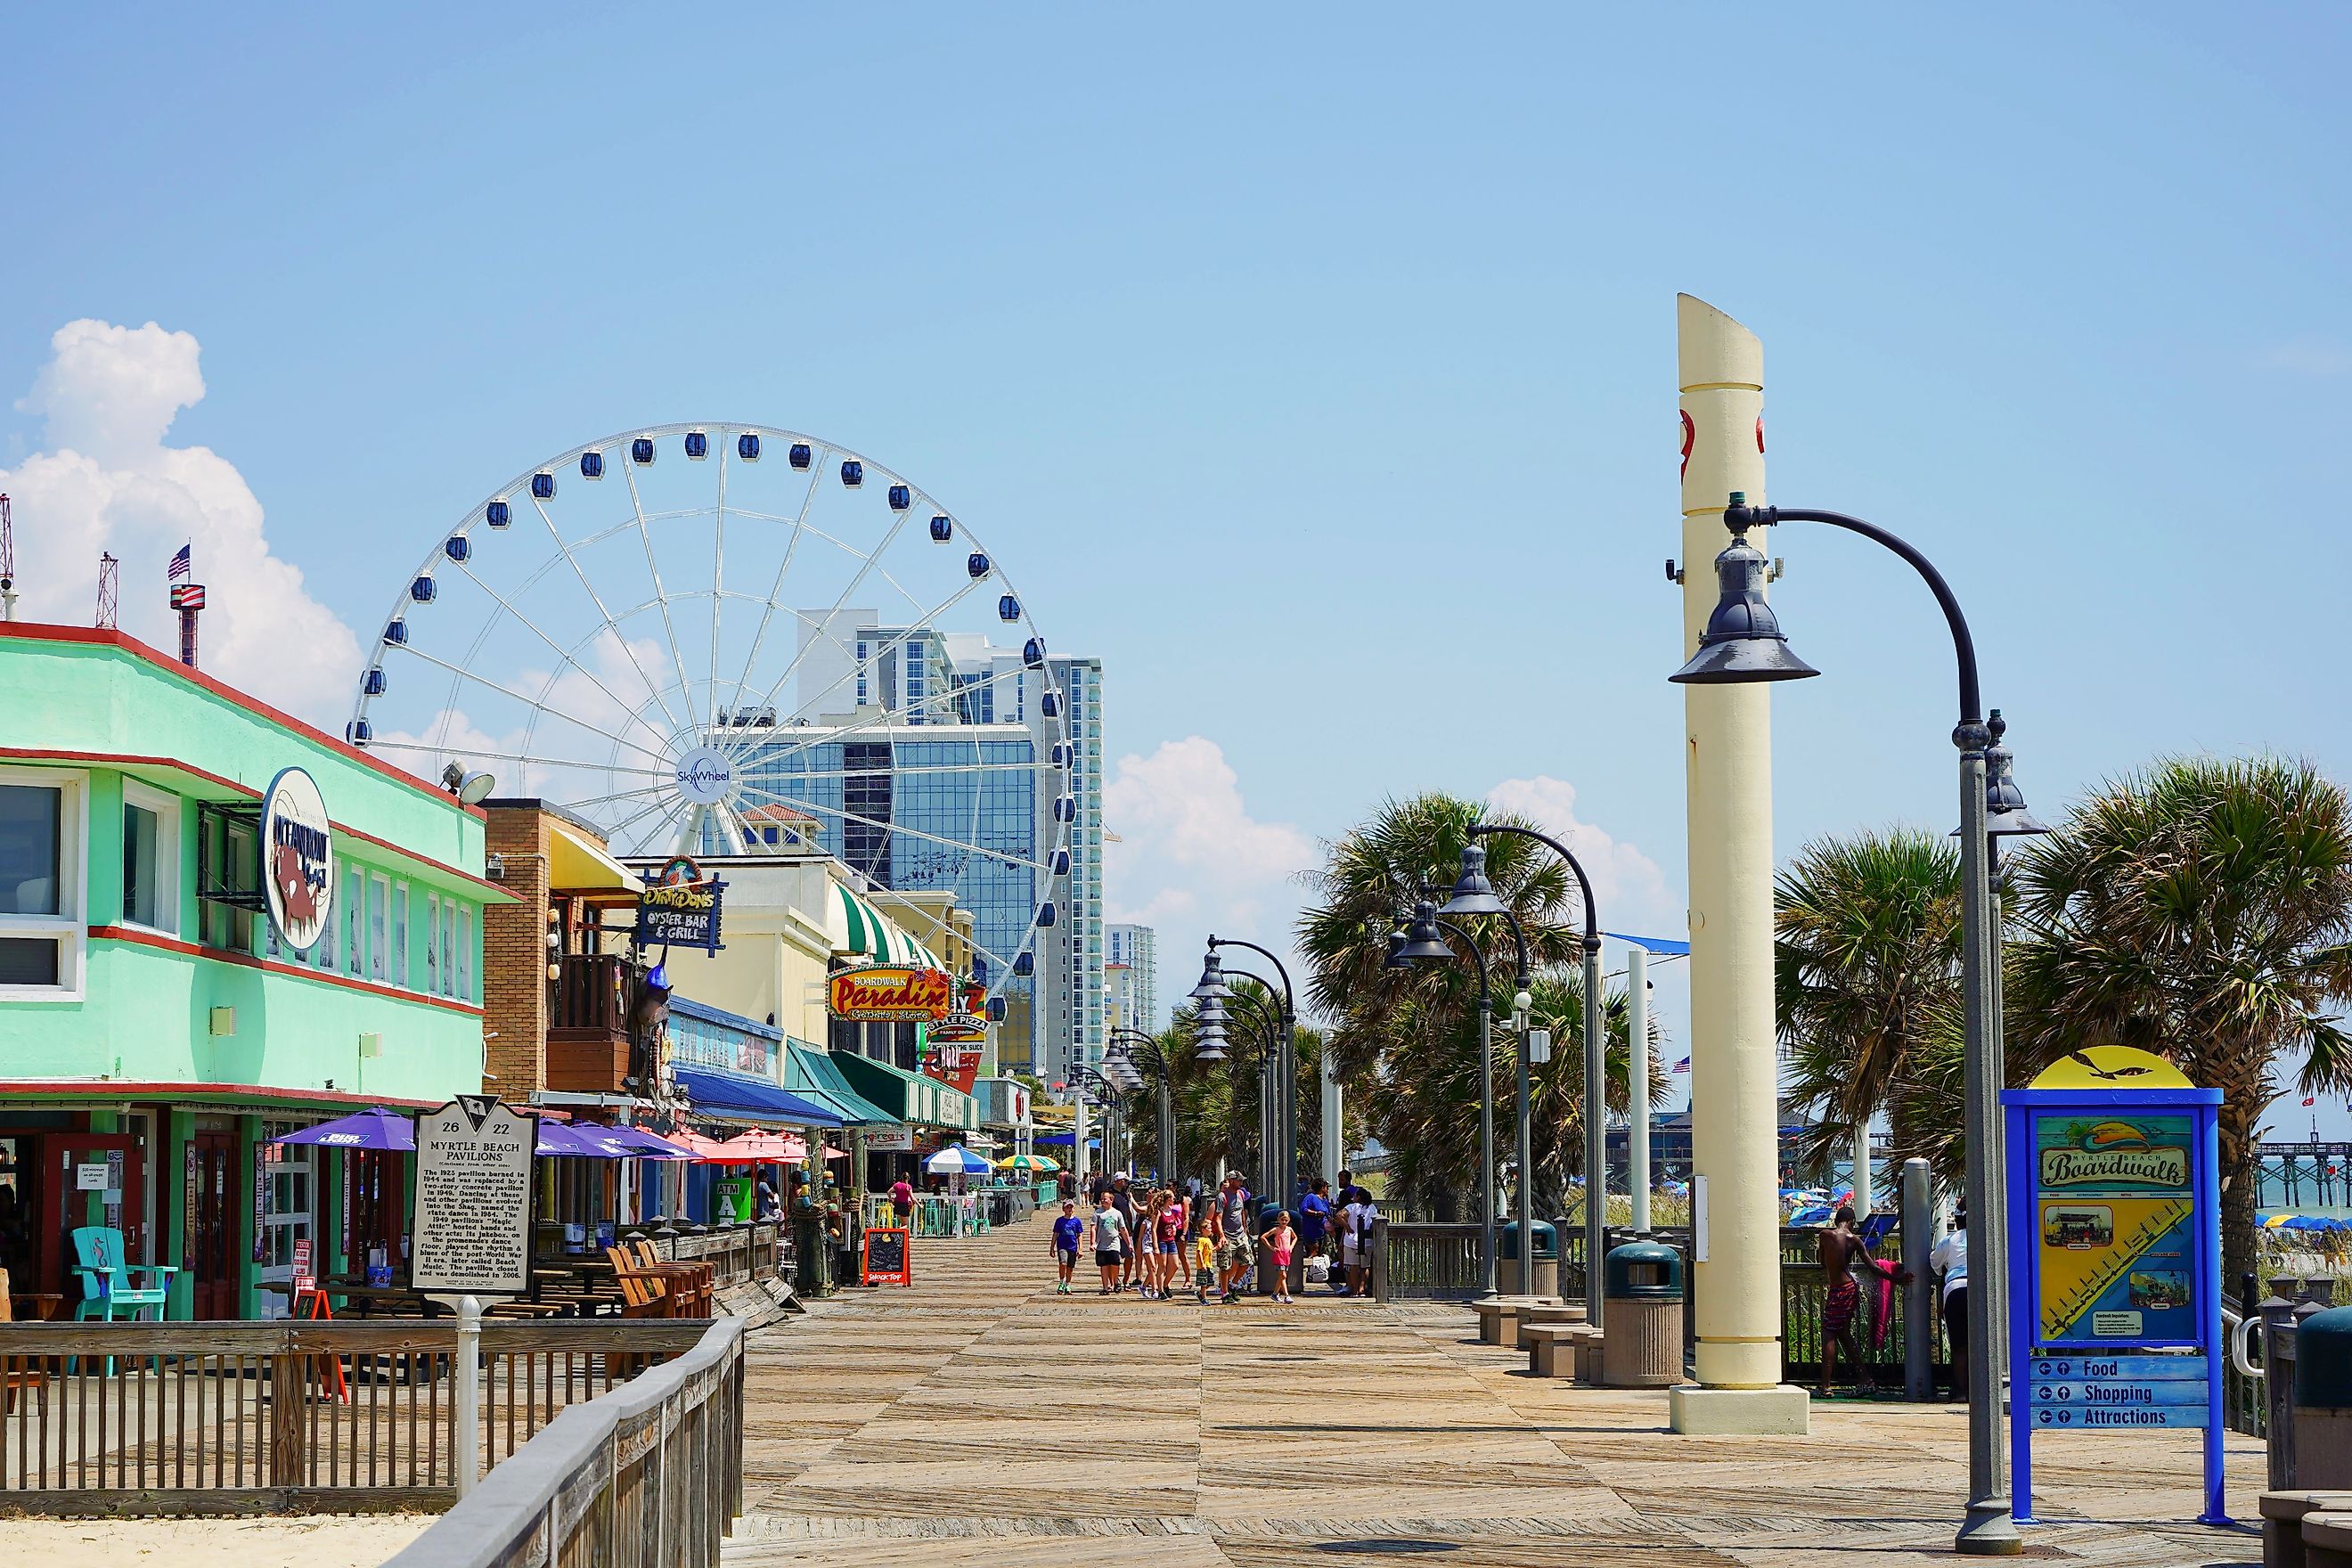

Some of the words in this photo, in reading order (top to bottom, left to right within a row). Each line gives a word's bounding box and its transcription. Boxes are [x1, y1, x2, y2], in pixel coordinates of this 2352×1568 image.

[678, 771, 729, 784] SkyWheel
[648, 911, 682, 925] OYSTER
[685, 915, 708, 928] BAR
[656, 926, 665, 937] &
[667, 927, 698, 939] GRILL
[854, 977, 906, 986] BOARDWALK
[837, 974, 946, 1013] Paradise
[851, 1009, 895, 1019] General
[898, 1010, 928, 1019] Store
[960, 1017, 985, 1030] PIZZA
[442, 1123, 460, 1132] 26
[493, 1124, 510, 1134] 22
[430, 1141, 477, 1151] MYRTLE
[483, 1143, 519, 1152] BEACH
[446, 1152, 502, 1161] PAVILIONS
[2045, 1155, 2182, 1184] Boardwalk
[475, 1178, 504, 1186] replaced
[495, 1185, 524, 1193] pavilion
[718, 1185, 738, 1194] ATM
[461, 1197, 492, 1205] pavilions
[2084, 1361, 2118, 1376] Food
[2085, 1385, 2152, 1403] Shopping
[2084, 1409, 2166, 1425] Attractions
